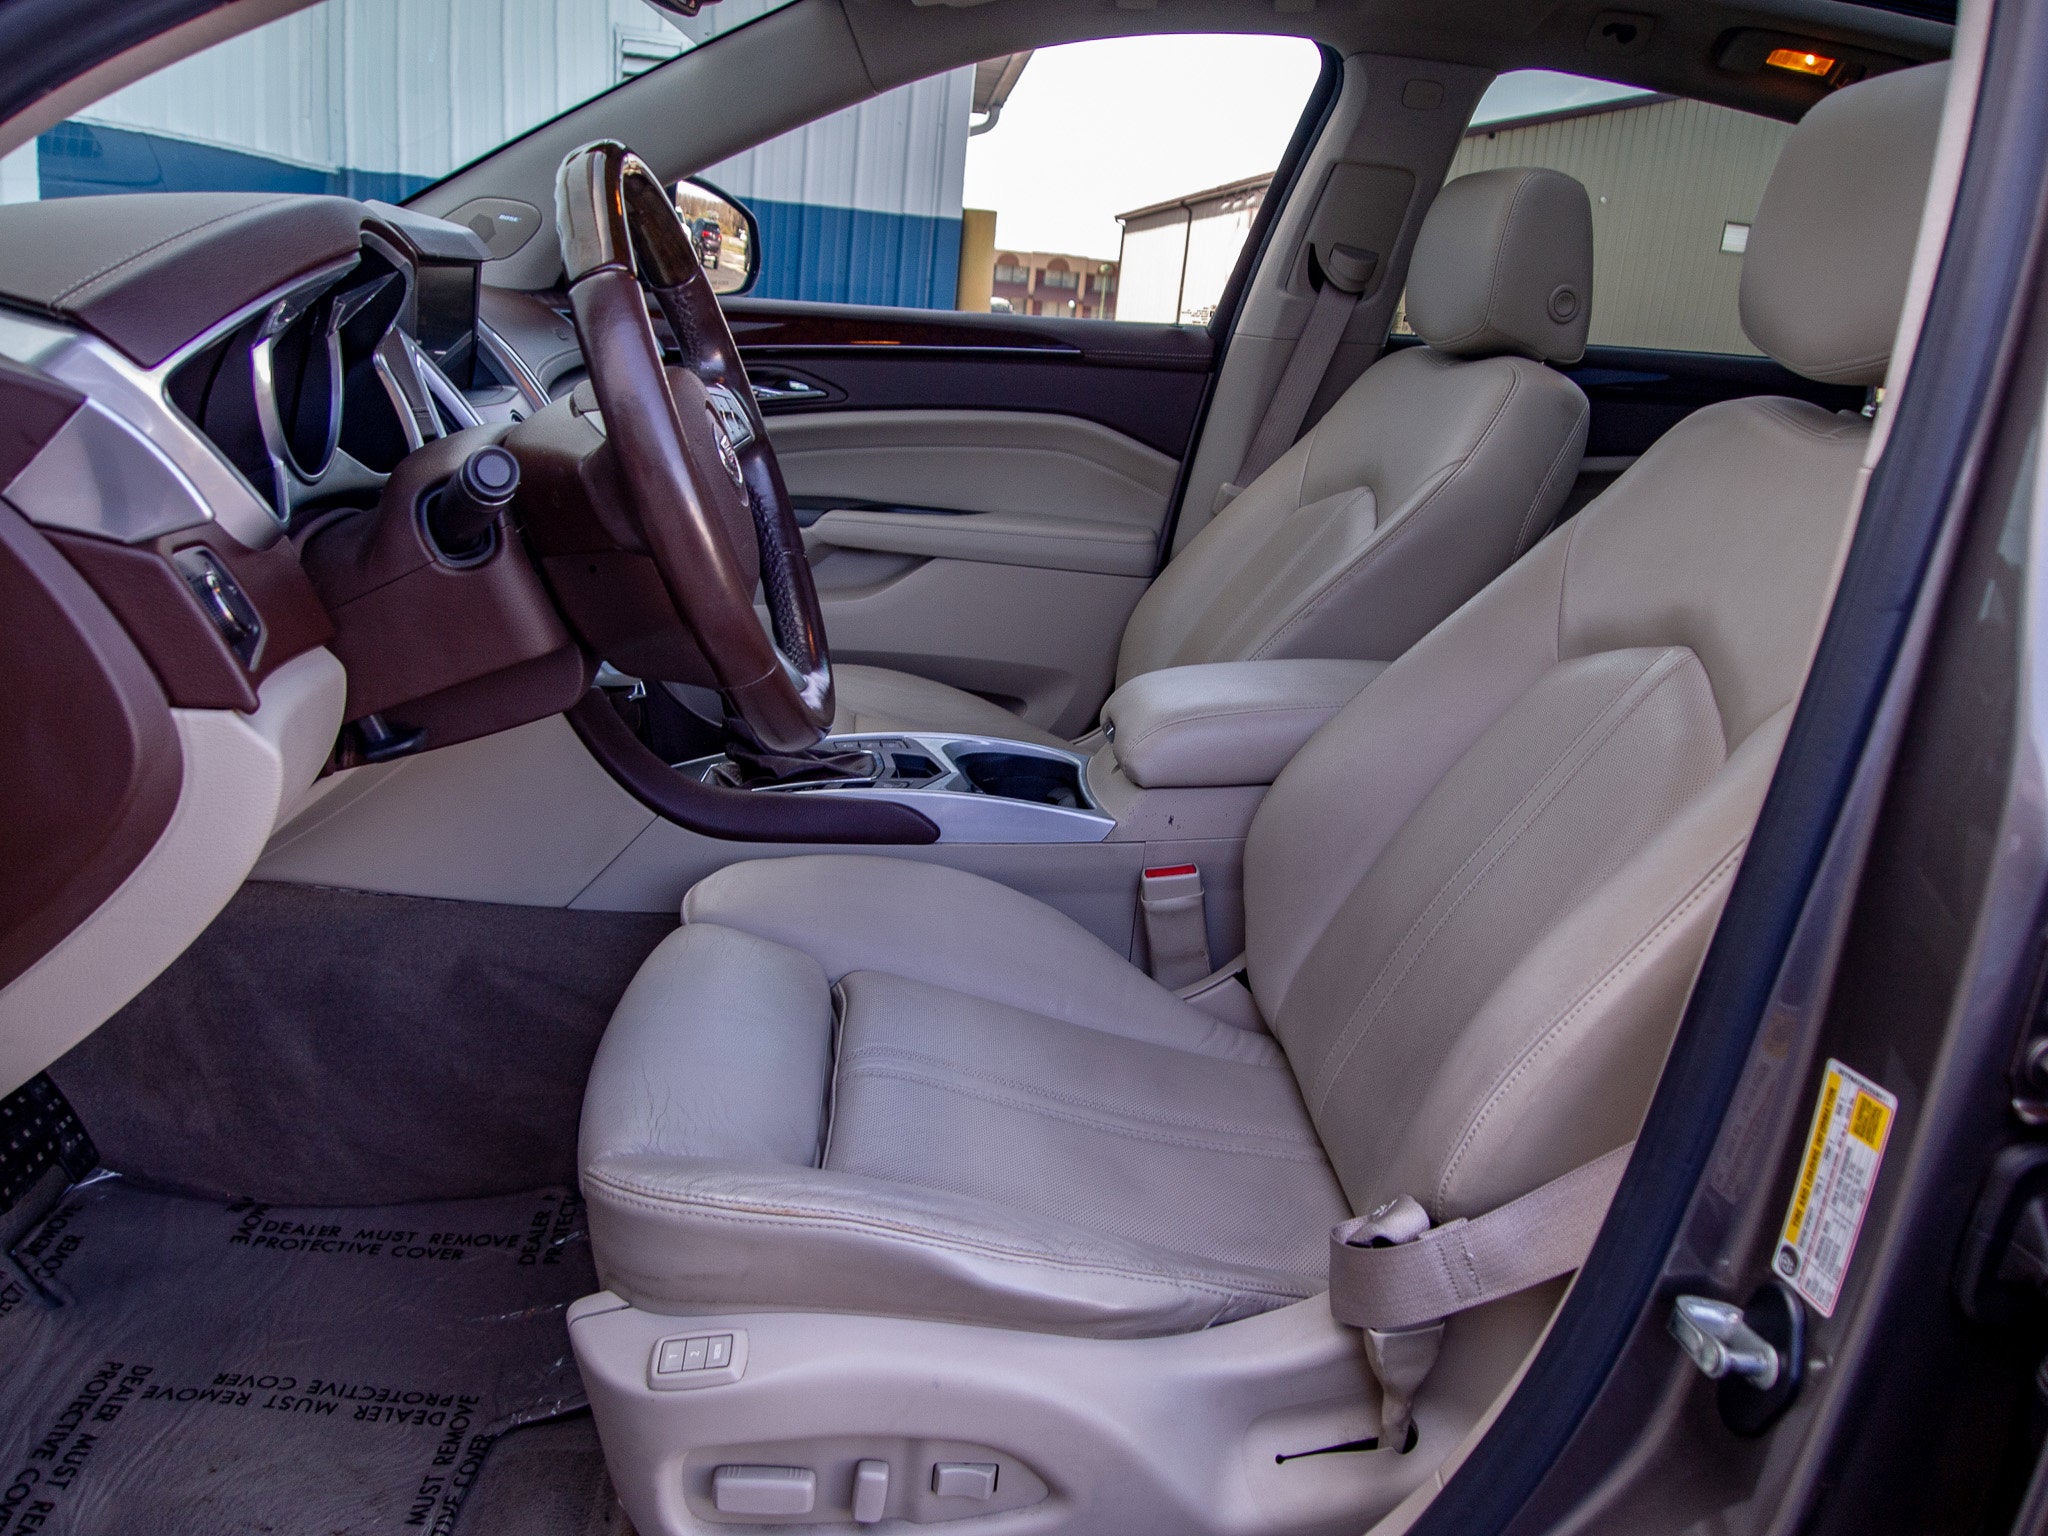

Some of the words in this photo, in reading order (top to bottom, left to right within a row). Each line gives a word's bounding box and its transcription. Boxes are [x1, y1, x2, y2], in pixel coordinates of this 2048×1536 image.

[252, 1235, 384, 1256] PROTECTIVE
[391, 1245, 465, 1261] COVER
[262, 1219, 342, 1237] DEALER
[354, 1229, 419, 1243] MUST
[429, 1232, 521, 1249] REMOVE
[518, 1209, 551, 1265] DEALER
[93, 1365, 153, 1422] DEALER
[141, 1385, 253, 1406] REMOVE
[212, 1373, 297, 1391] COVER
[306, 1379, 454, 1407] PROTECTIVE
[30, 1361, 124, 1461] PROTECTIVE
[262, 1394, 339, 1416] MUST
[353, 1404, 447, 1427] DEALER
[47, 1433, 98, 1490] MUST
[404, 1475, 445, 1526] MUST
[431, 1394, 480, 1466] REMOVE
